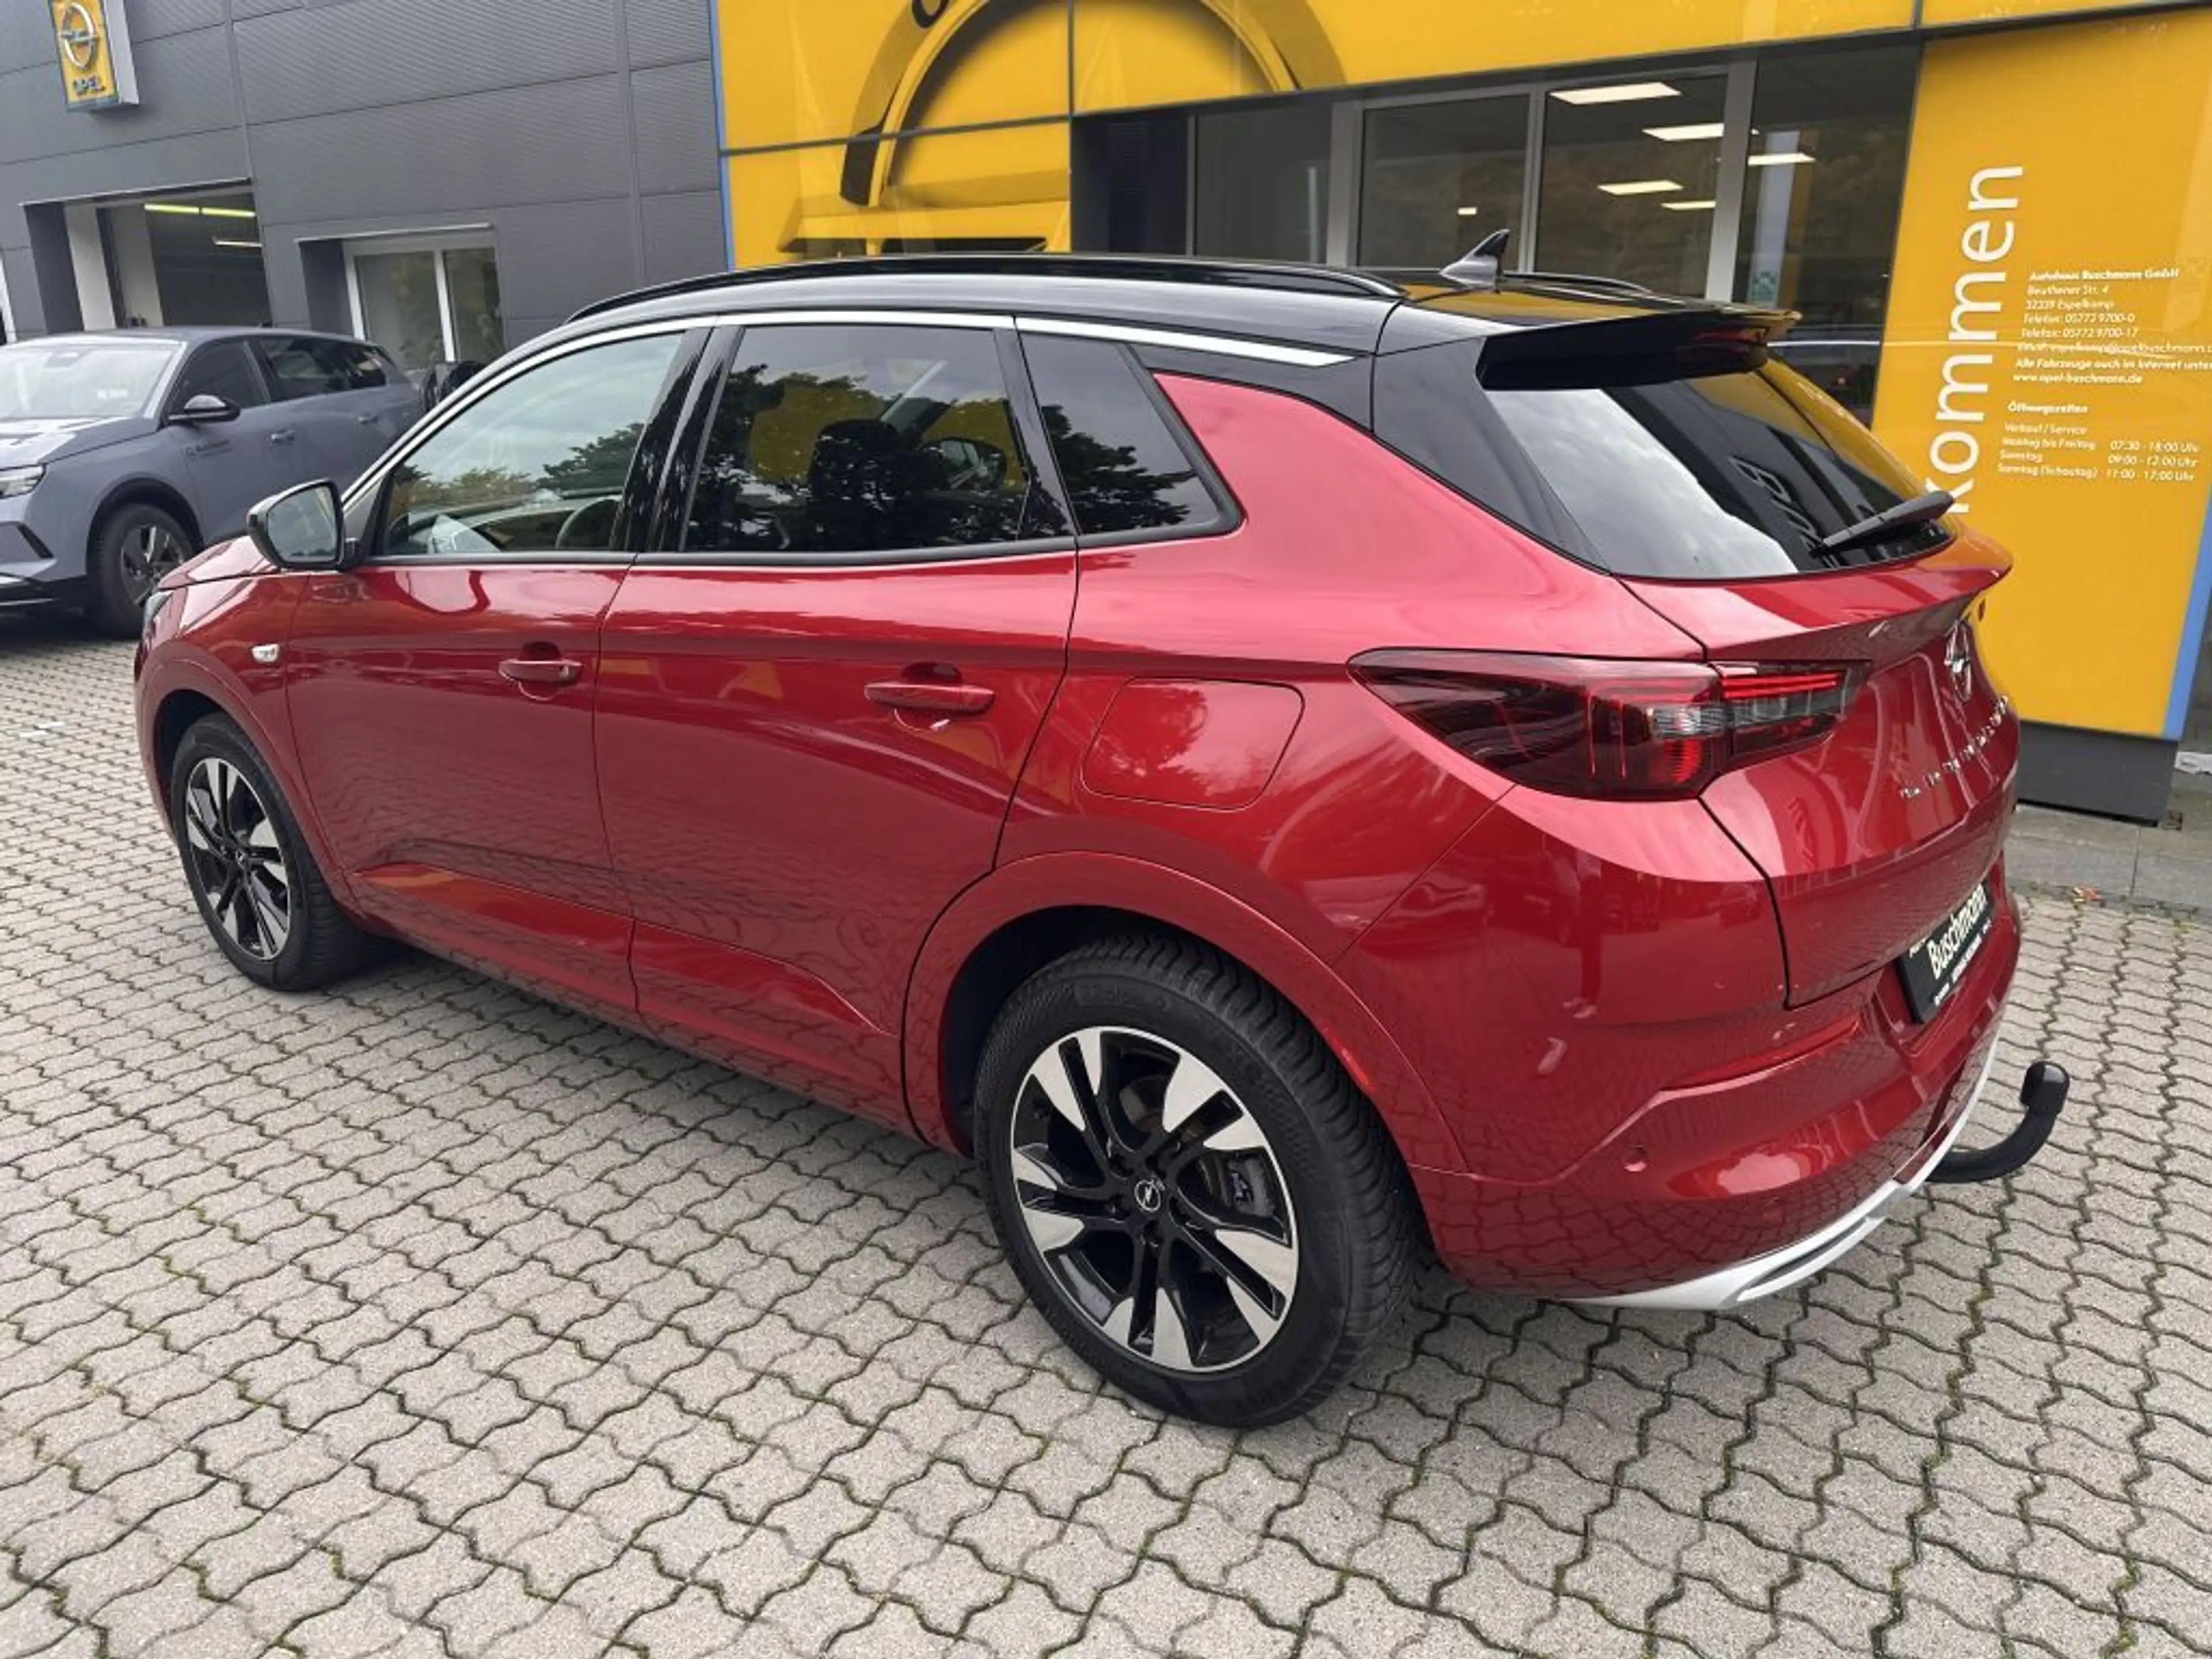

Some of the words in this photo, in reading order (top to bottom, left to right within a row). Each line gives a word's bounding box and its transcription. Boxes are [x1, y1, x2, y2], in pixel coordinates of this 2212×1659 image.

[2029, 271, 2080, 281] Autohaus
[2081, 270, 2143, 281] Buschmann
[2145, 268, 2179, 278] GmbH
[2101, 285, 2109, 294] 4
[2016, 358, 2035, 368] Alle
[2037, 358, 2092, 370] Fahrzeuge
[2094, 359, 2120, 369] auch
[2123, 359, 2135, 369] im
[2139, 359, 2182, 370] Internet
[2008, 400, 2088, 415] Öffnungszeiten
[2005, 422, 2042, 433] Verkauf
[2050, 424, 2088, 435] Service
[2059, 438, 2096, 451] Freitag
[2180, 441, 2199, 453] Uhr
[2178, 457, 2198, 468] Uhr
[2175, 471, 2194, 482] Uhr
